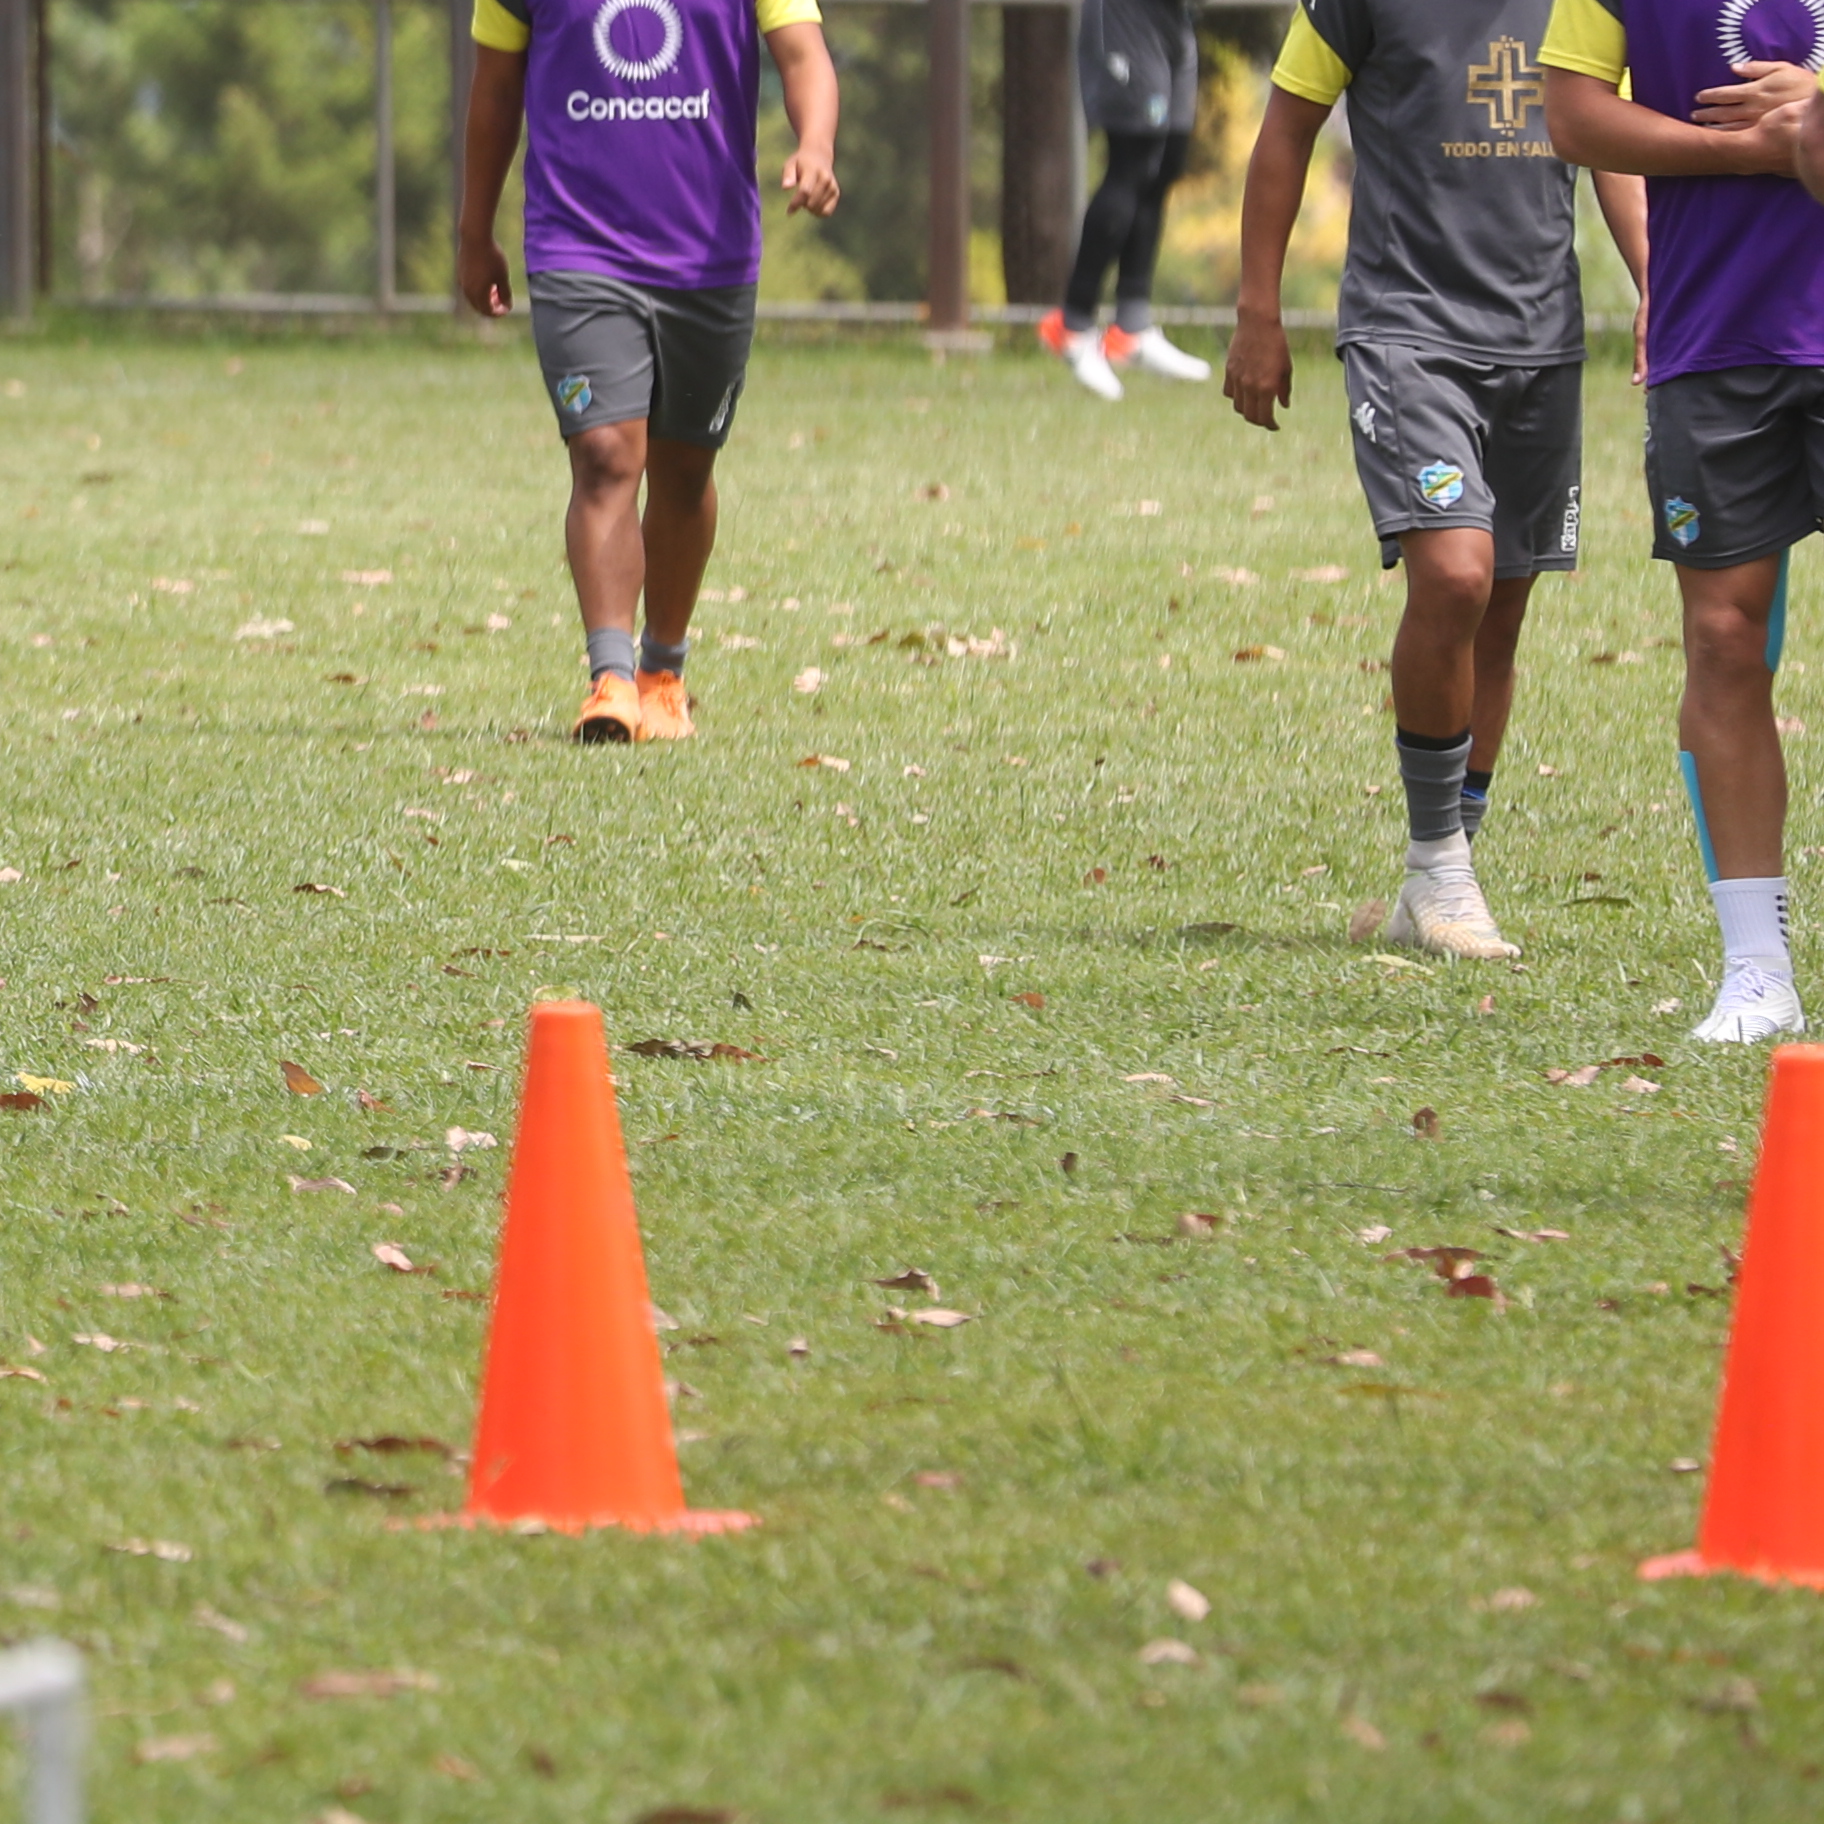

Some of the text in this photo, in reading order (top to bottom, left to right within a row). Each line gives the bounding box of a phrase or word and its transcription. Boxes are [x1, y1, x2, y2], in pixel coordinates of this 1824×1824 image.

[567, 88, 711, 122] Concacaf
[1441, 142, 1492, 157] TODO
[1495, 142, 1520, 157] EN
